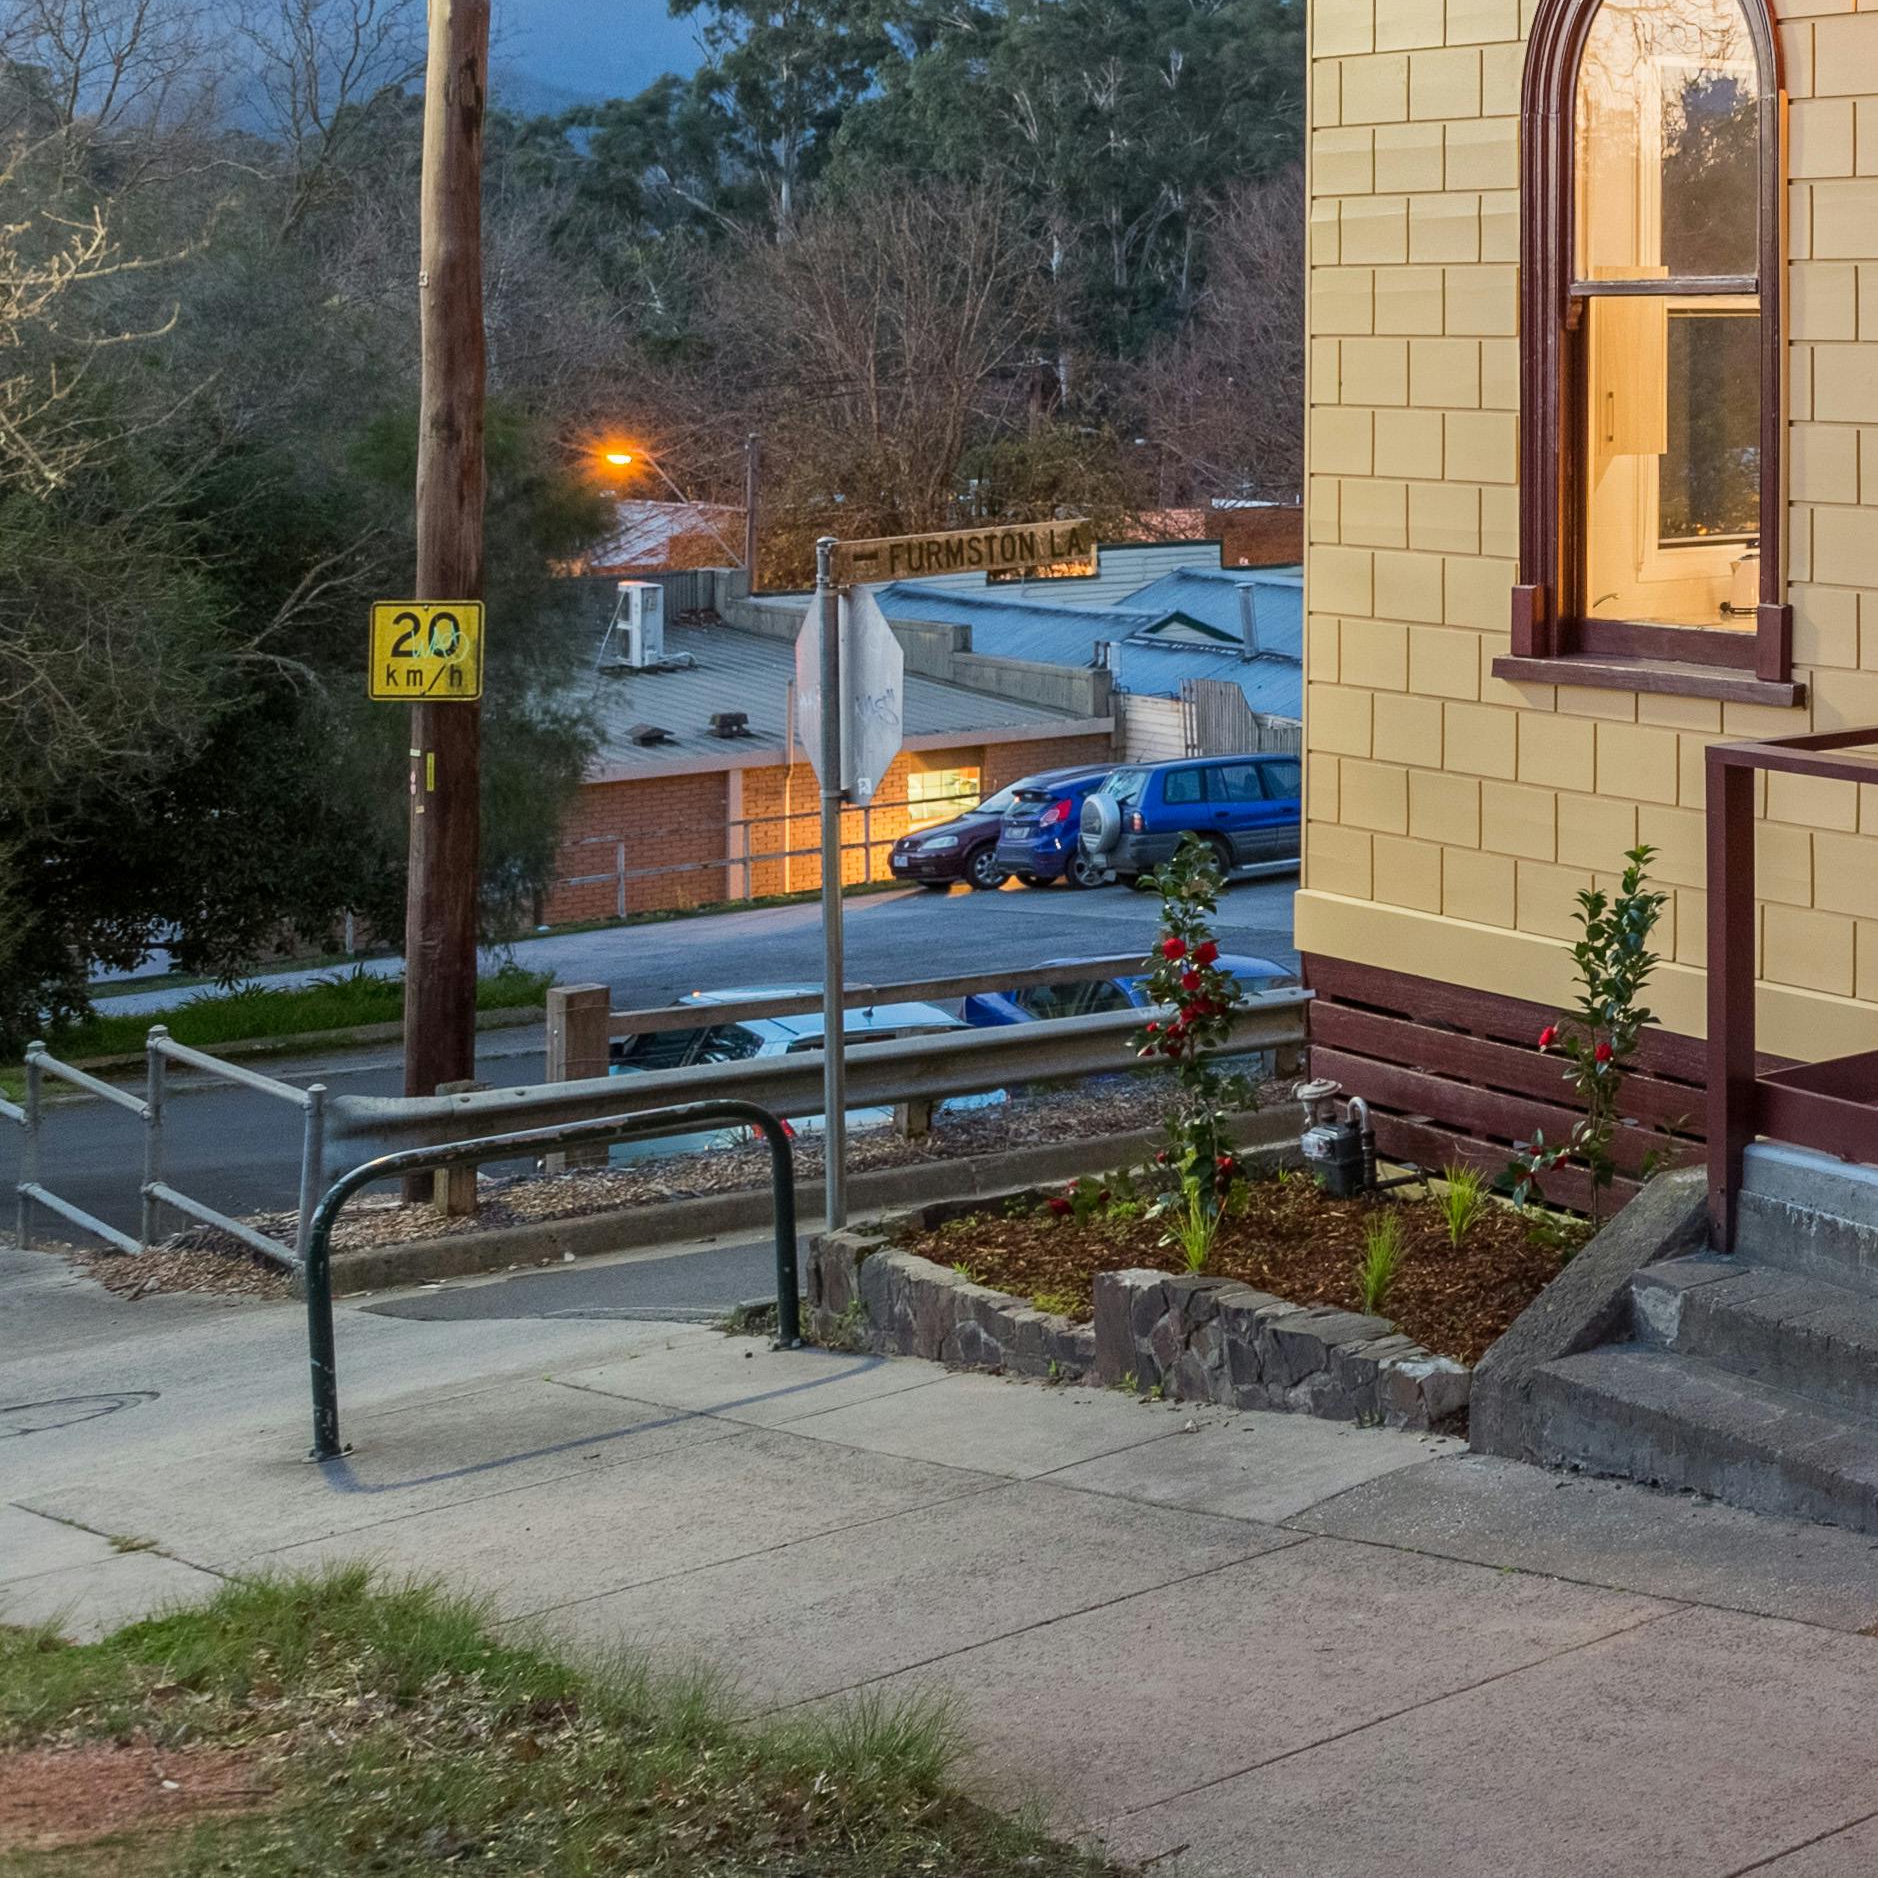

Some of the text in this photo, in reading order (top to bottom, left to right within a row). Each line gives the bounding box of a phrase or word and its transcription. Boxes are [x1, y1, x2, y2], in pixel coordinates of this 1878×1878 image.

[889, 527, 1084, 574] FURMSTON LA
[391, 612, 461, 658] 20
[386, 663, 463, 692] km/h
